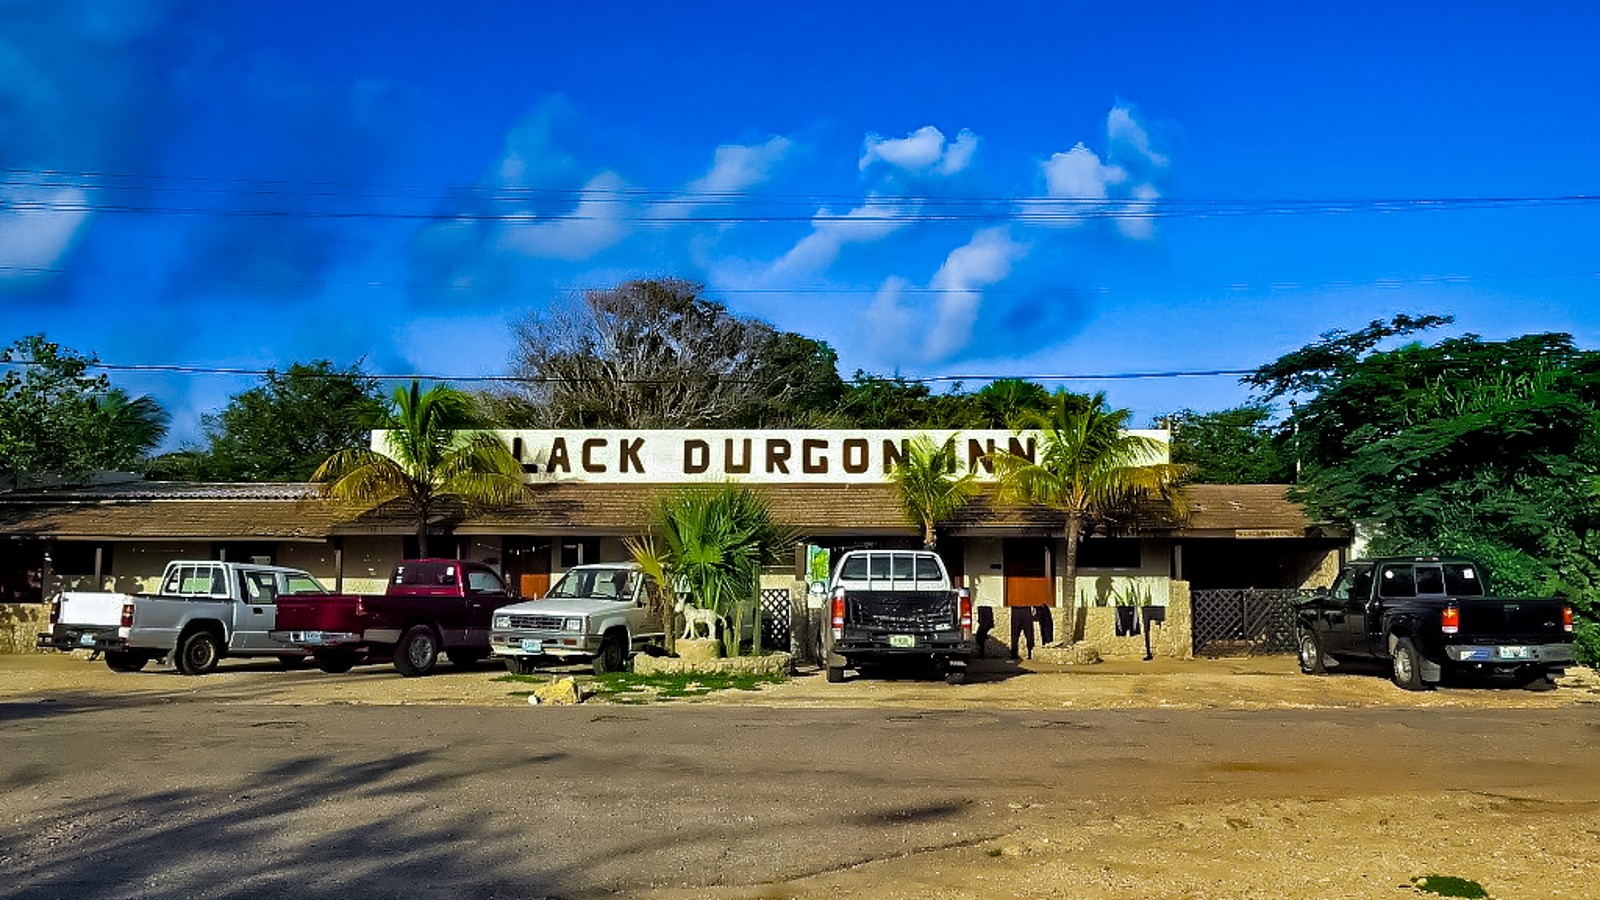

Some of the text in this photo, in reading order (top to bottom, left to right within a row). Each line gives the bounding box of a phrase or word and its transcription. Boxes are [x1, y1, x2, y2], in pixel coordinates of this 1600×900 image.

[512, 437, 1036, 474] LACK DURGON INN
